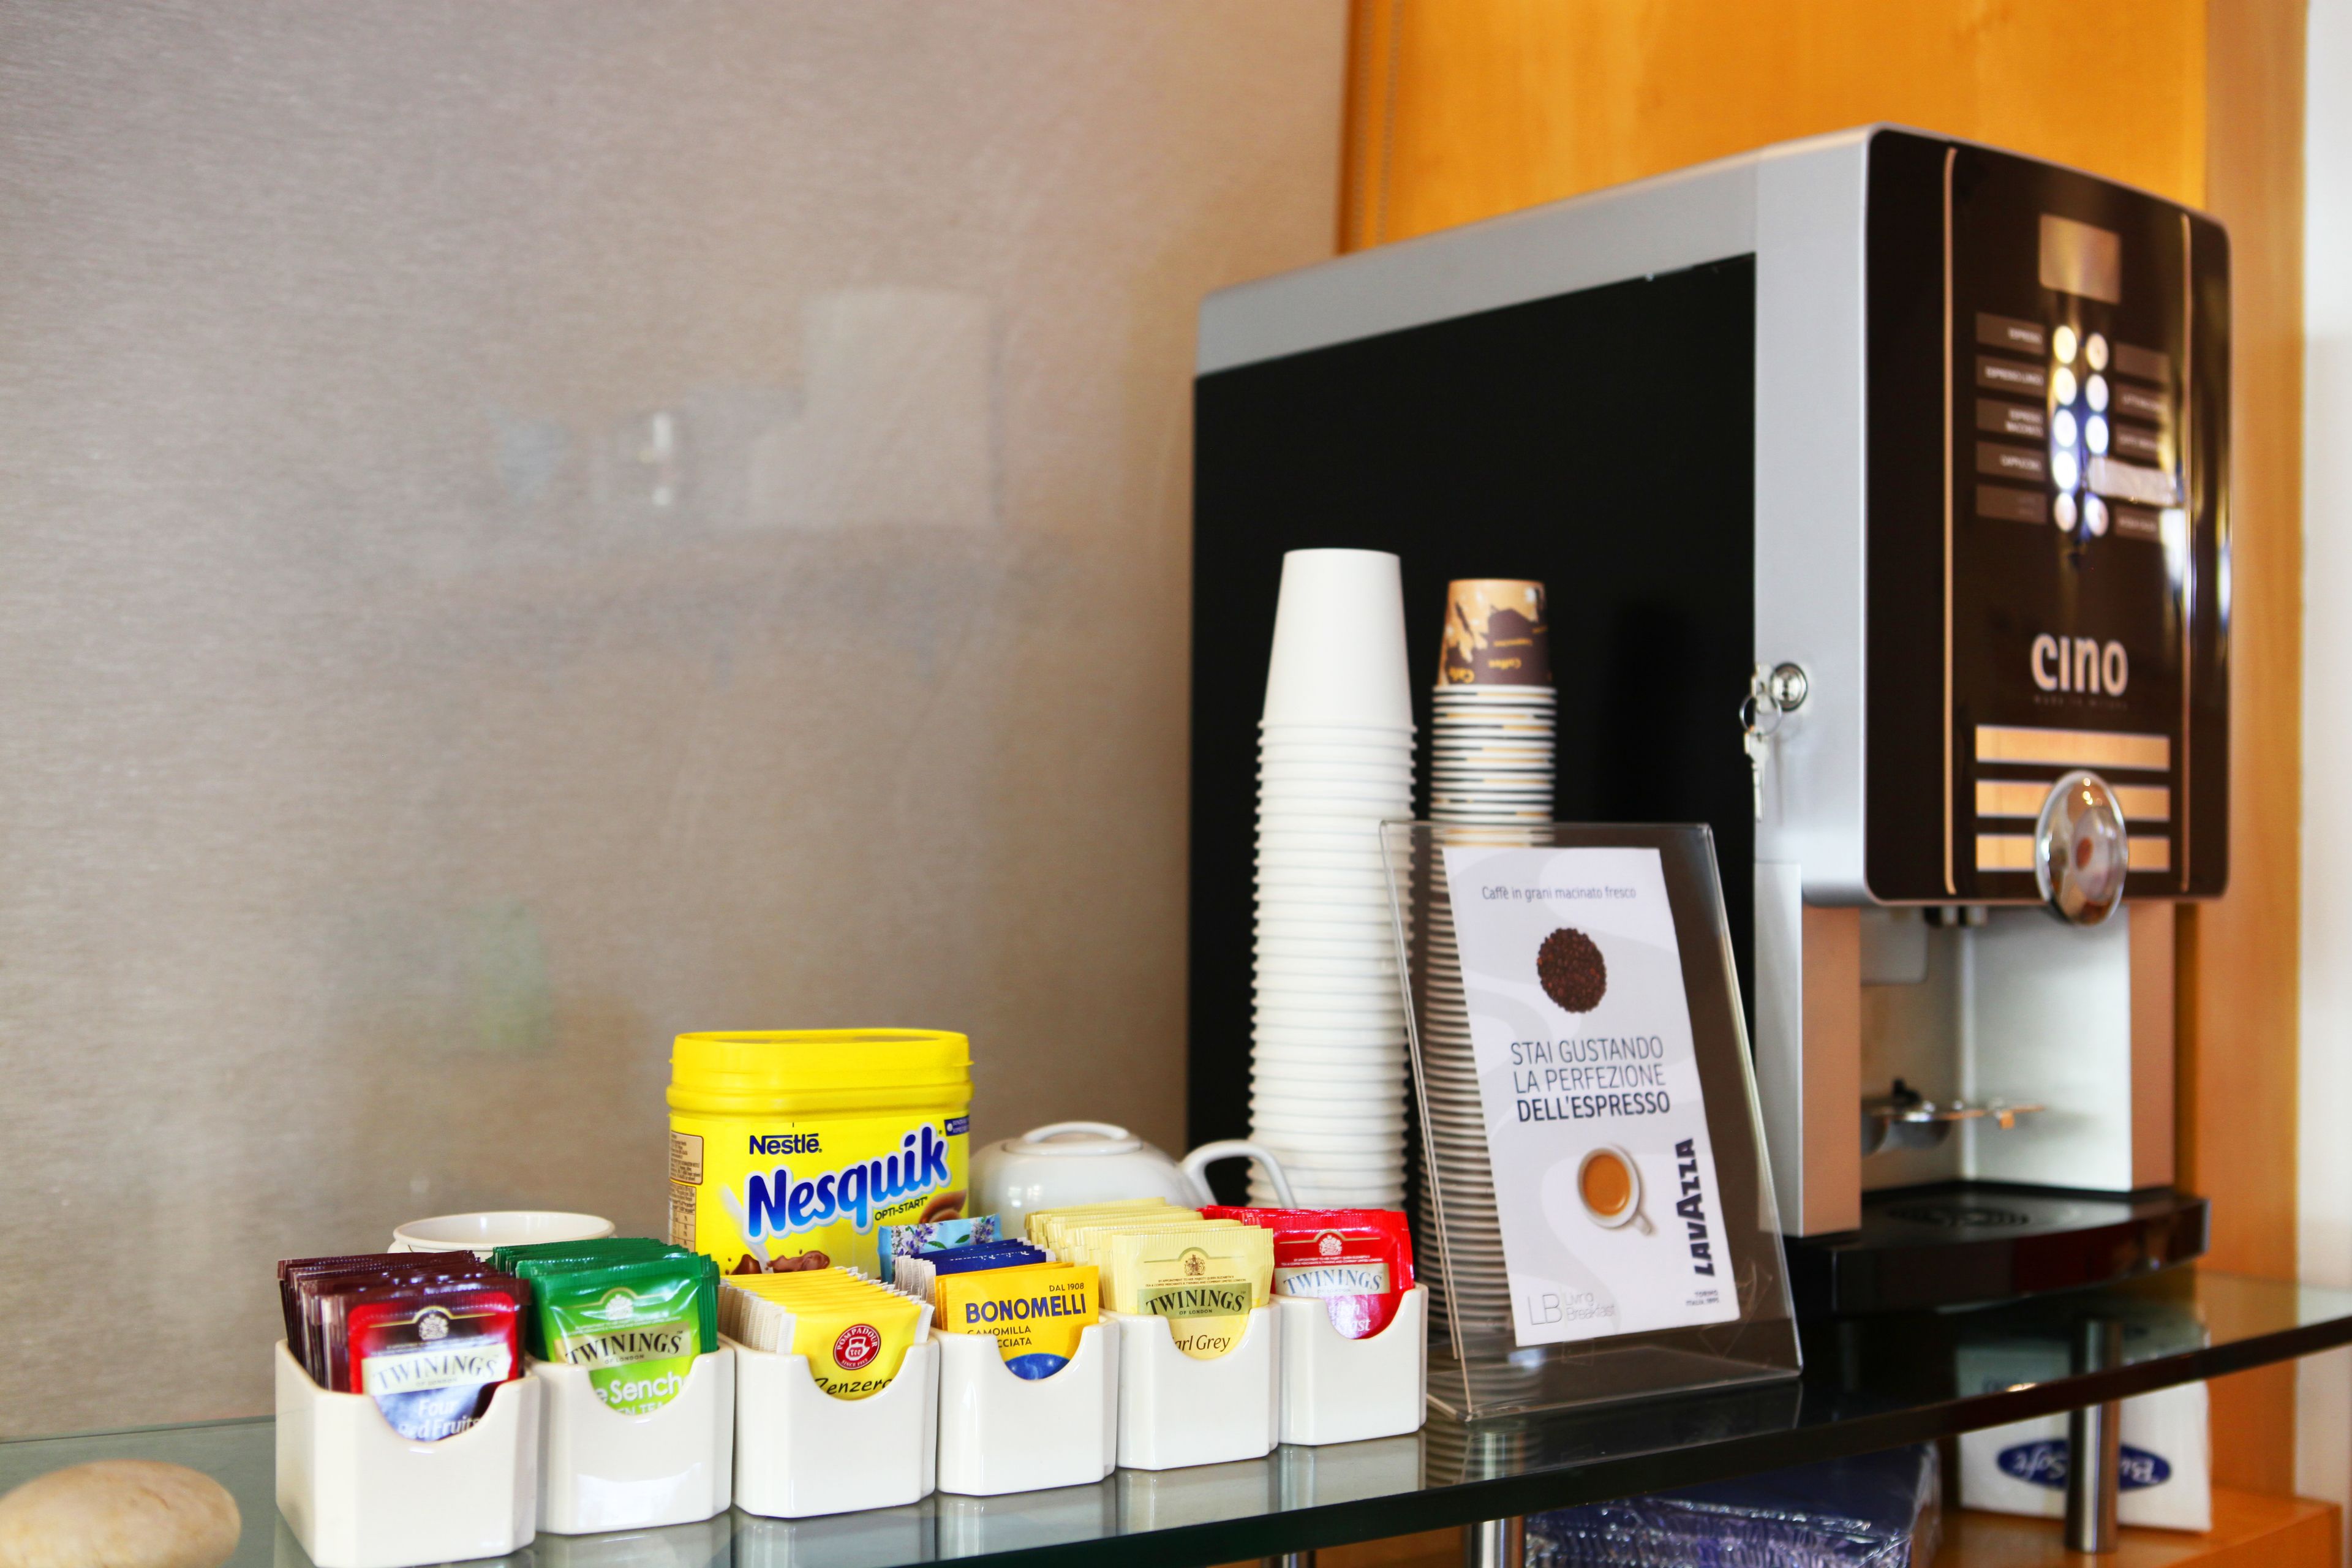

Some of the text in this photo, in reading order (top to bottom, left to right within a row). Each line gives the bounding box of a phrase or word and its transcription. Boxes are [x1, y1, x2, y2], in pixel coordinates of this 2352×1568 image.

[2031, 633, 2128, 697] cino
[1482, 885, 1637, 903] Caffè in grani macinato fresco
[1510, 1036, 1664, 1065] STAI GUSTANDO
[1513, 1063, 1666, 1094] LA PERFEZIONE
[1517, 1091, 1671, 1123] DELL'ESPRESSO
[748, 1125, 949, 1238] Nesquik
[1675, 1137, 1716, 1277] LAVAZZA
[1067, 1282, 1085, 1291] 1908
[1283, 1269, 1382, 1295] TWININGS
[965, 1293, 1087, 1324] BONOMELLI
[1145, 1289, 1245, 1316] TWININGS
[565, 1332, 682, 1365] TWININGS
[836, 1327, 878, 1350] POMPADOUR
[1173, 1334, 1231, 1352] arl Grey
[373, 1355, 497, 1390] TWININGS
[610, 1371, 684, 1403] Sench
[418, 1398, 458, 1417] Four
